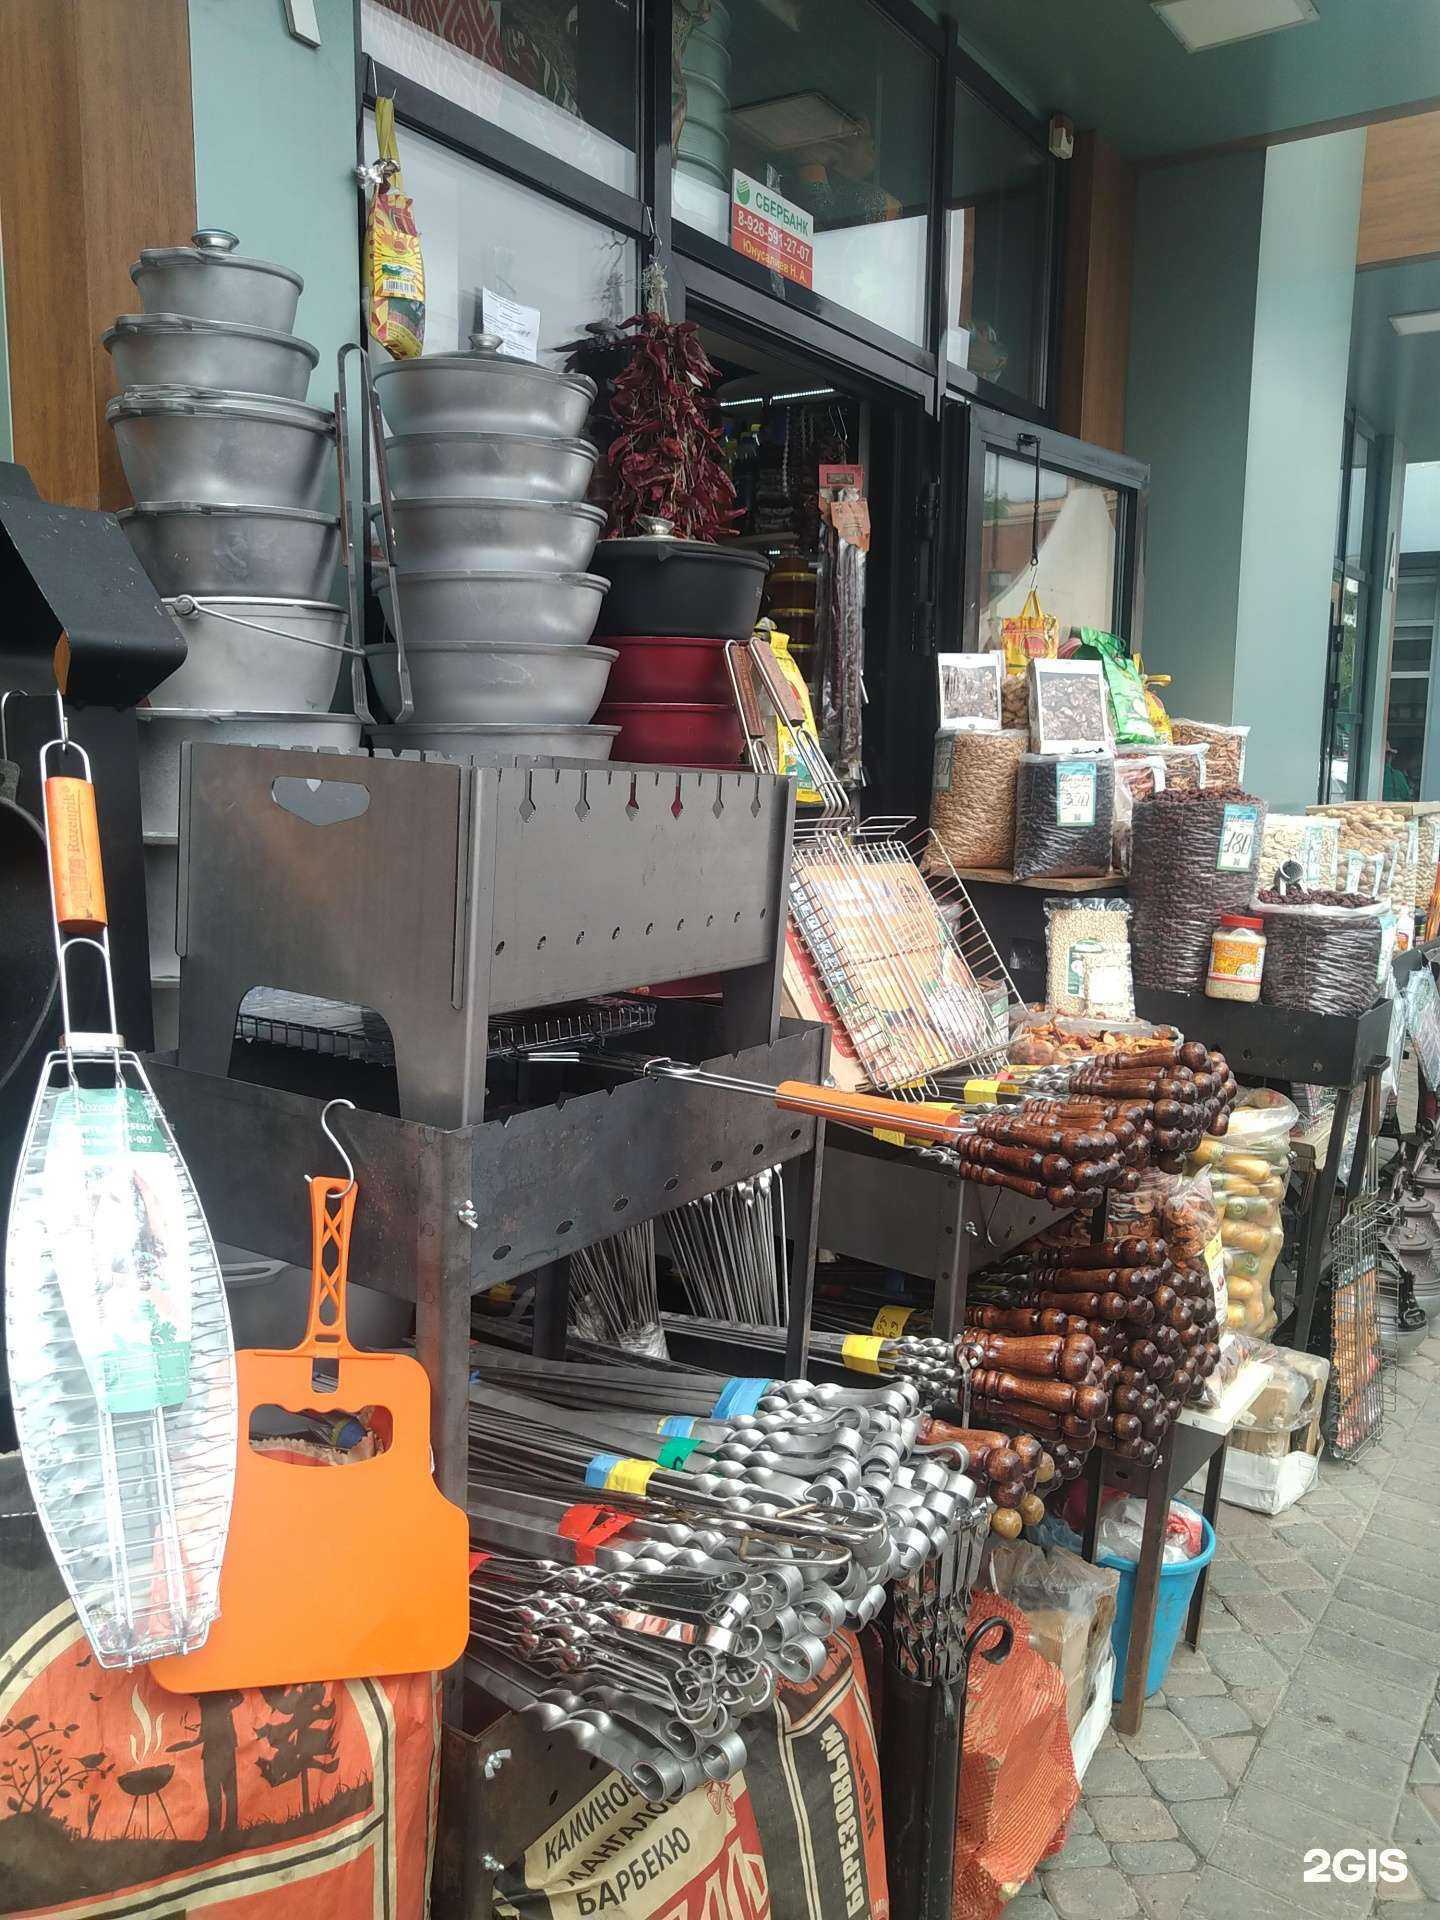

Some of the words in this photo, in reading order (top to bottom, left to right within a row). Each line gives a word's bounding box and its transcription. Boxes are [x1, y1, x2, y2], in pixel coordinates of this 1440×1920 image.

[738, 210, 810, 263] 8-926-591-27-07
[755, 192, 809, 237] СБЕРБАНК
[559, 1794, 681, 1888] МАНГАЛО
[820, 1723, 866, 1919] БЕРЕЗОВЫЙ
[576, 1826, 691, 1917] БАРБЕКЮ
